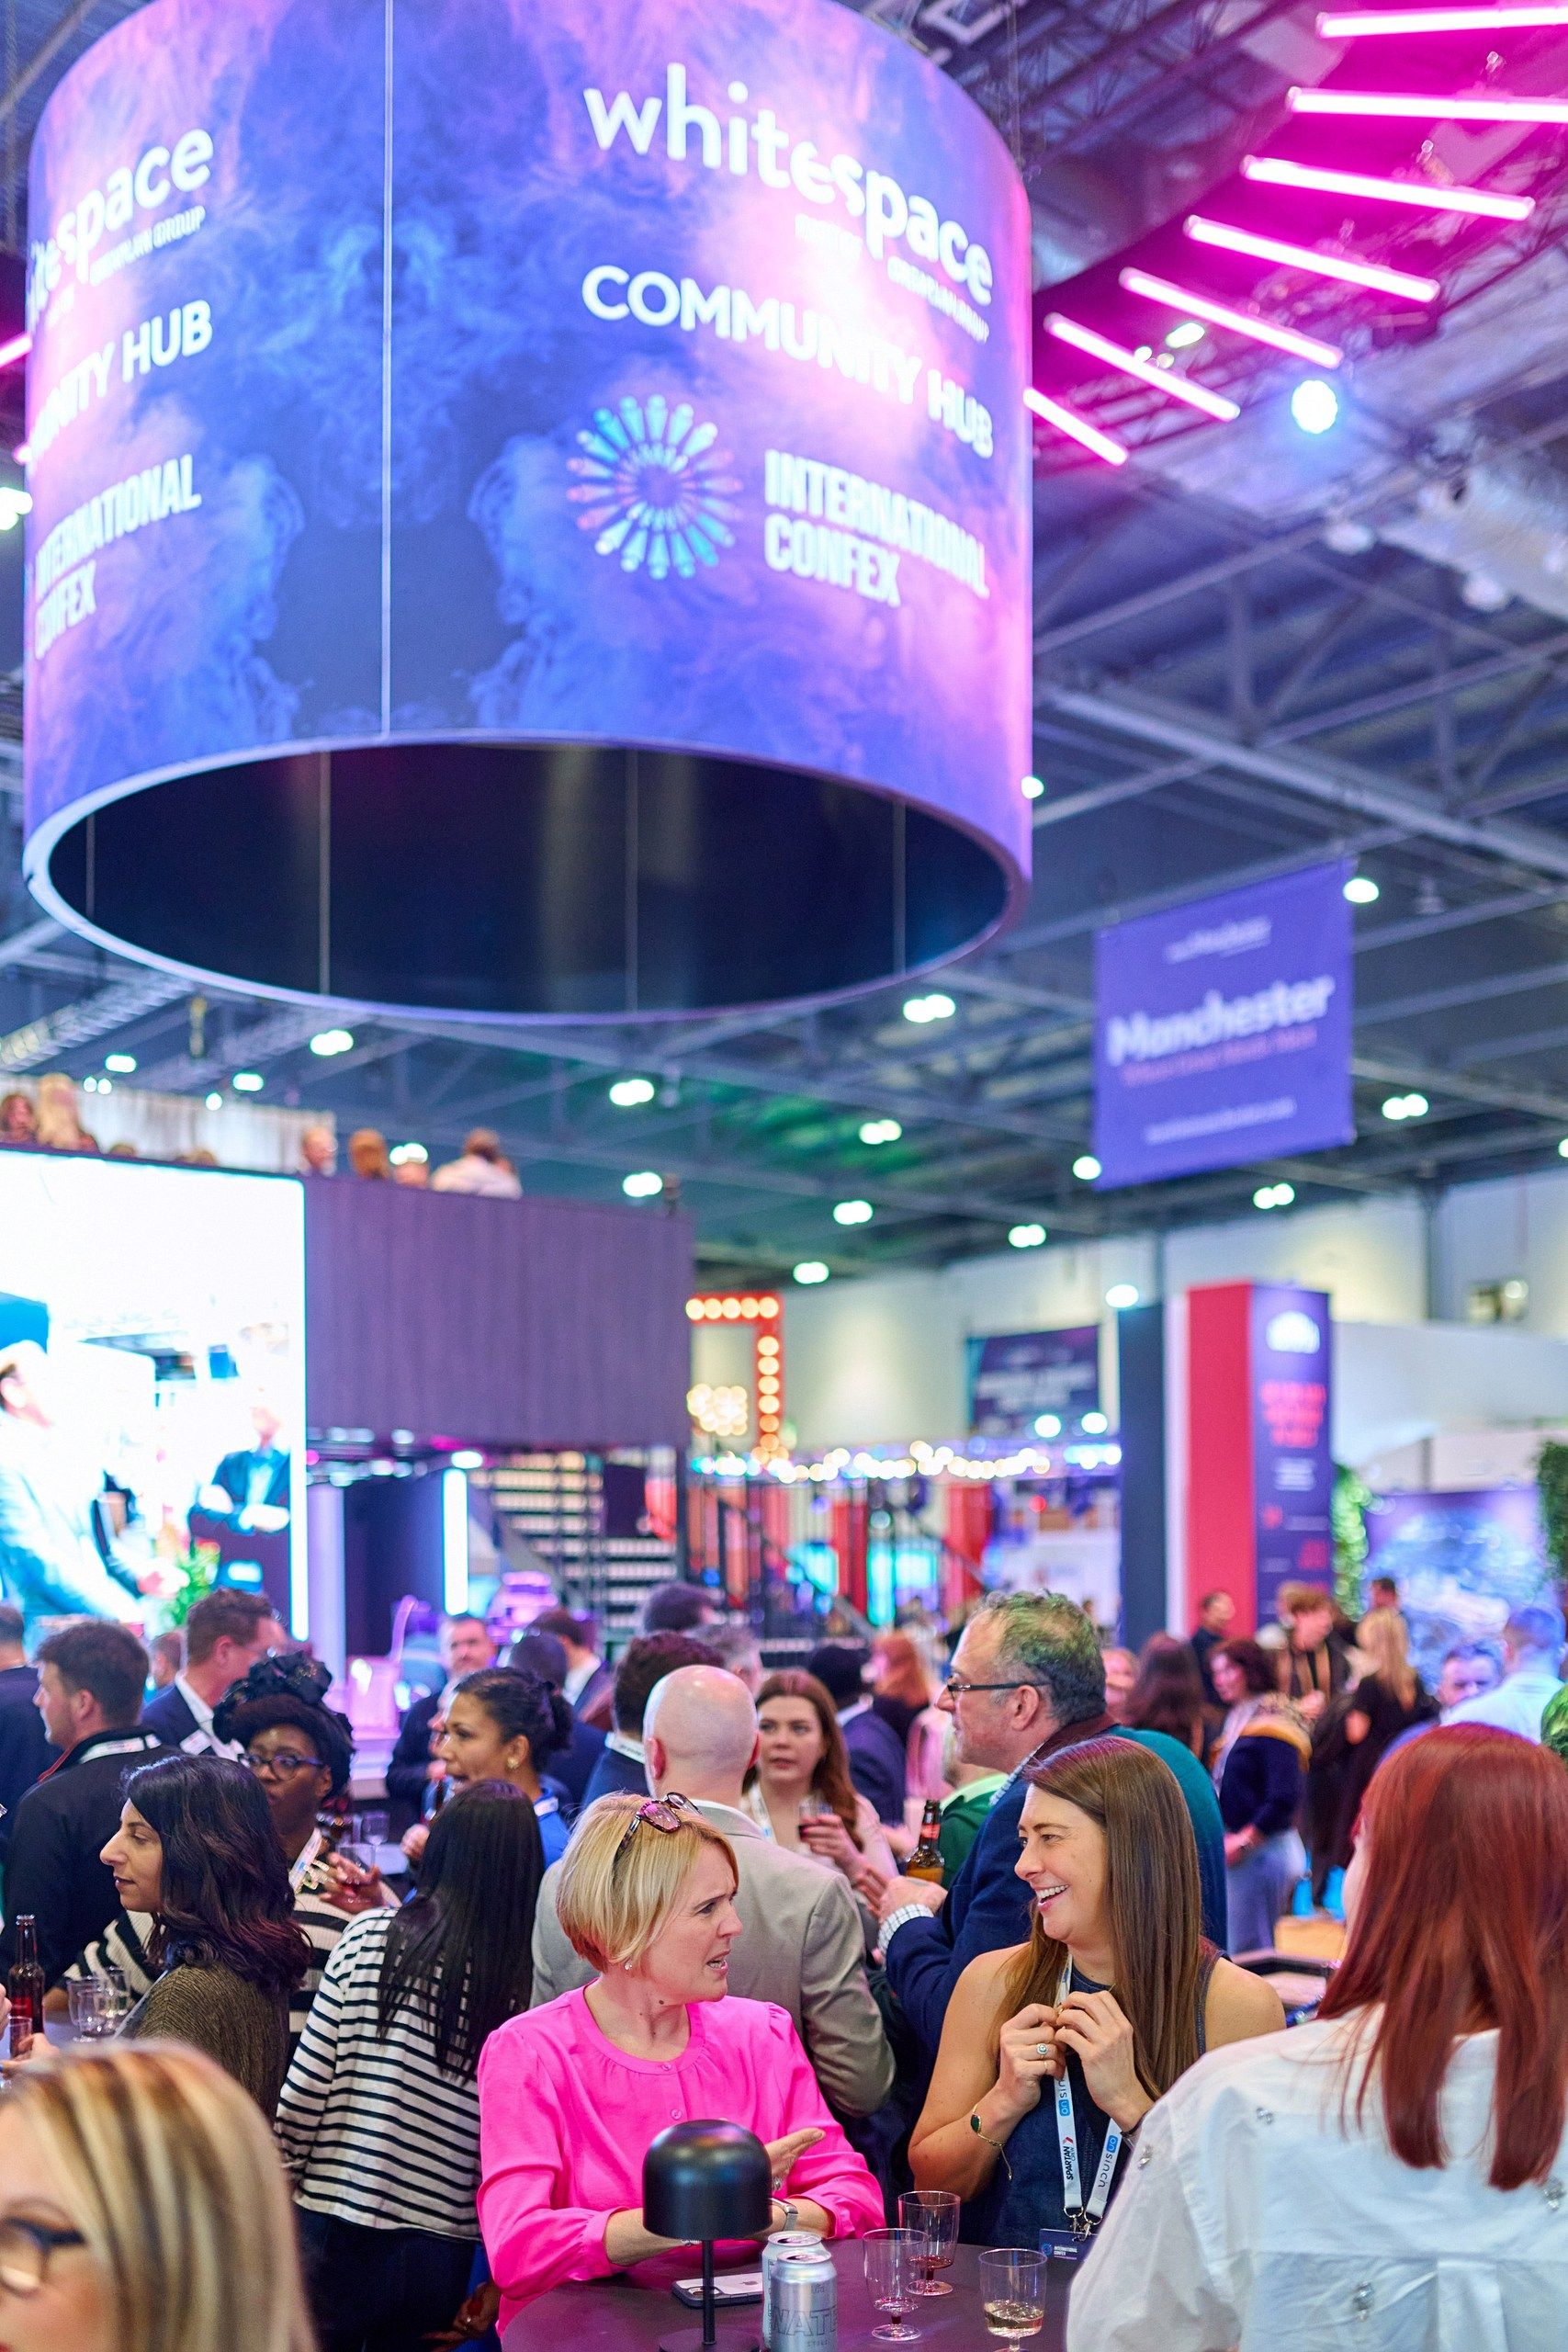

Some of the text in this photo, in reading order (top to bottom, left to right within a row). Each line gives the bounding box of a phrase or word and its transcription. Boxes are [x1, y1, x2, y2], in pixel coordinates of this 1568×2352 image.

[582, 62, 993, 306] whitespace
[122, 300, 213, 384] HUB
[581, 265, 922, 404] COMMUNITY
[927, 368, 994, 458] HUB
[764, 513, 901, 608] CONFEX
[1107, 974, 1336, 1067] Manchester
[1063, 2145, 1074, 2181] SPARTAN
